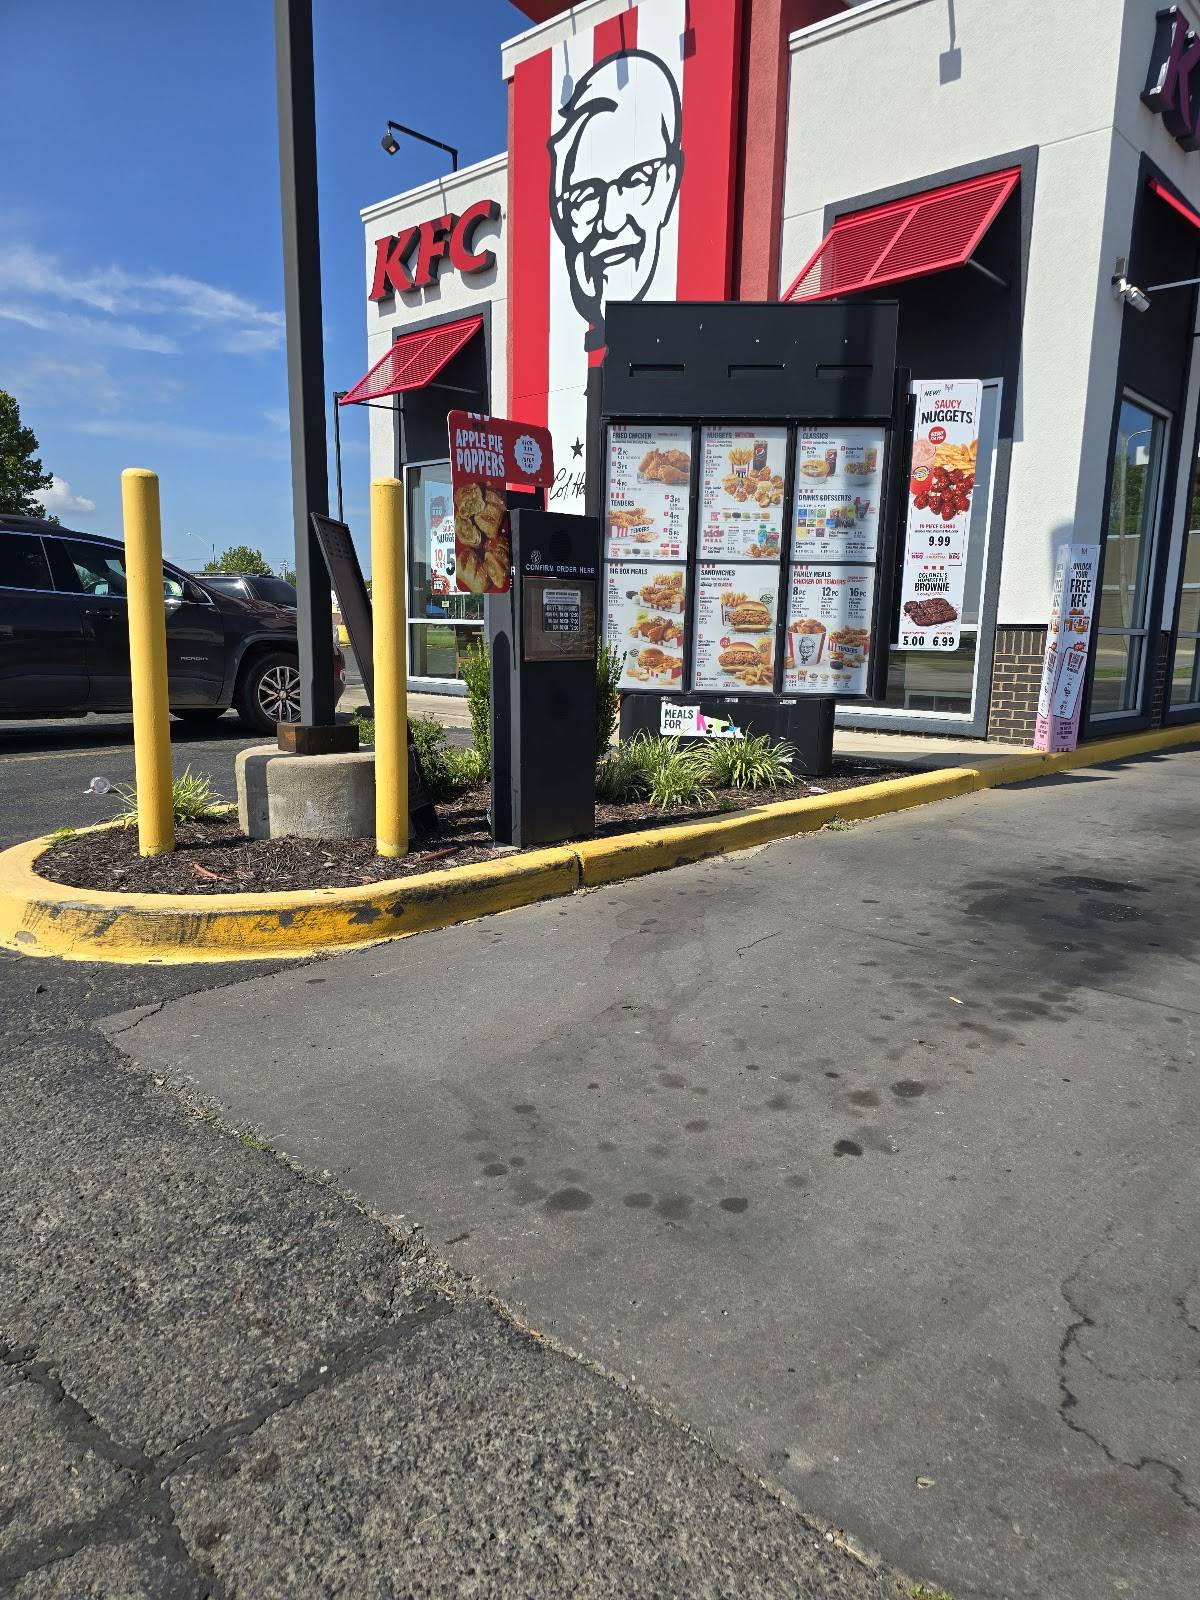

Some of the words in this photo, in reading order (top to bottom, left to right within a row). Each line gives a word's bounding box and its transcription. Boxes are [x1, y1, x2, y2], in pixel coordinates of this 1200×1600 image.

[368, 199, 501, 302] KFC
[935, 400, 962, 409] SAUCY
[921, 410, 973, 424] NUGGETS
[612, 432, 628, 440] FRIED
[628, 432, 652, 440] CHICKEN
[706, 431, 733, 439] NUGGETS
[802, 432, 829, 440] CLASSICS
[456, 428, 487, 449] APPLE
[487, 434, 504, 454] PIE
[456, 448, 505, 478] POPPERS
[611, 499, 635, 507] TENDERS
[798, 494, 819, 502] DRINKS
[928, 535, 951, 546] 9.99
[525, 563, 554, 572] CONFIRM
[556, 565, 577, 573] ORDER
[579, 566, 595, 574] HERE
[1073, 562, 1093, 571] UNLOCK
[700, 569, 736, 577] SANDWICHES
[1075, 570, 1089, 579] YOUR
[914, 582, 950, 592] BROWNIE
[1069, 579, 1092, 593] FREE
[1070, 593, 1088, 608] KFC
[902, 635, 925, 646] 5.00
[932, 636, 955, 647] 6.99
[664, 708, 694, 720] MEALS
[663, 719, 682, 729] FOR
